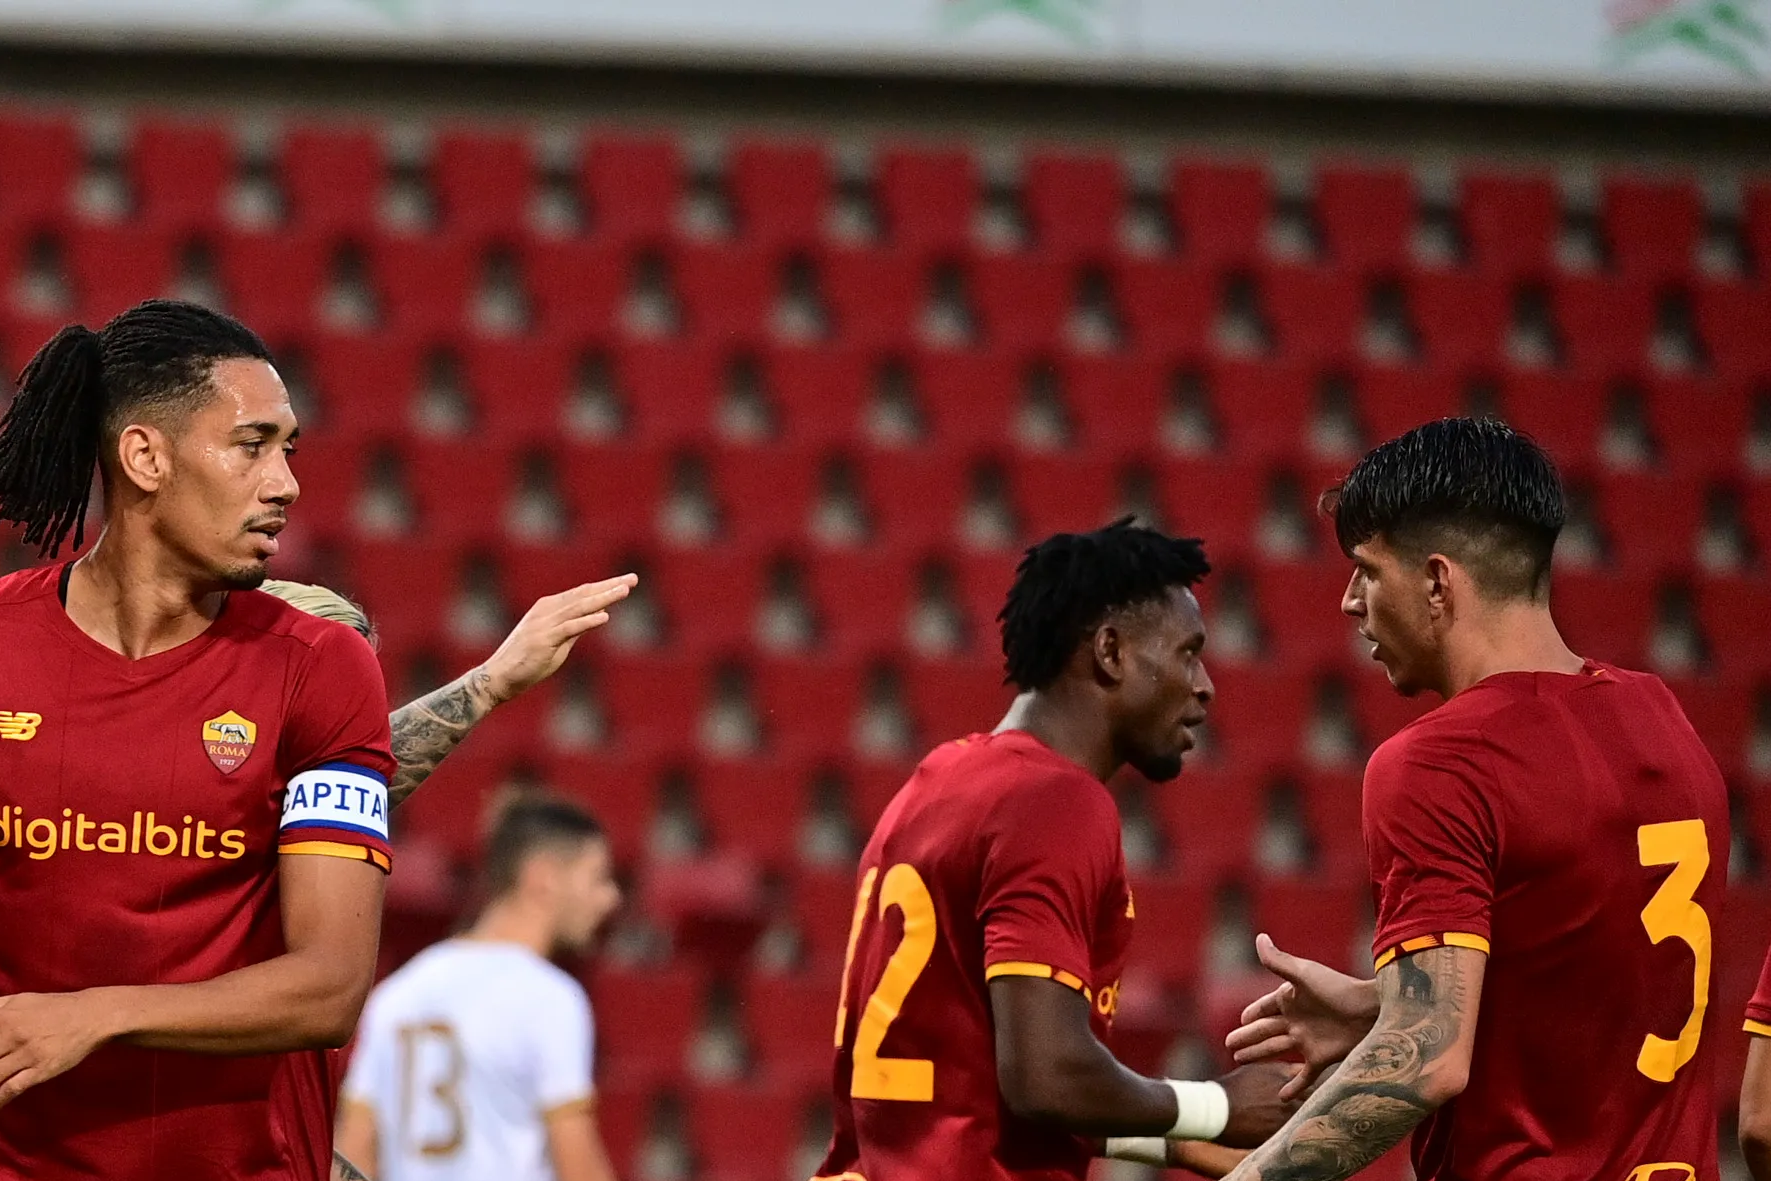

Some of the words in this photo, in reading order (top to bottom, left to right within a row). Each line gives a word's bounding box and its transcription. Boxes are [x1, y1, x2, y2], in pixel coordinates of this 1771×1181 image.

[208, 744, 248, 758] ROMA
[219, 758, 236, 766] 1927
[1636, 818, 1712, 1083] 3
[396, 1020, 469, 1167] 13
